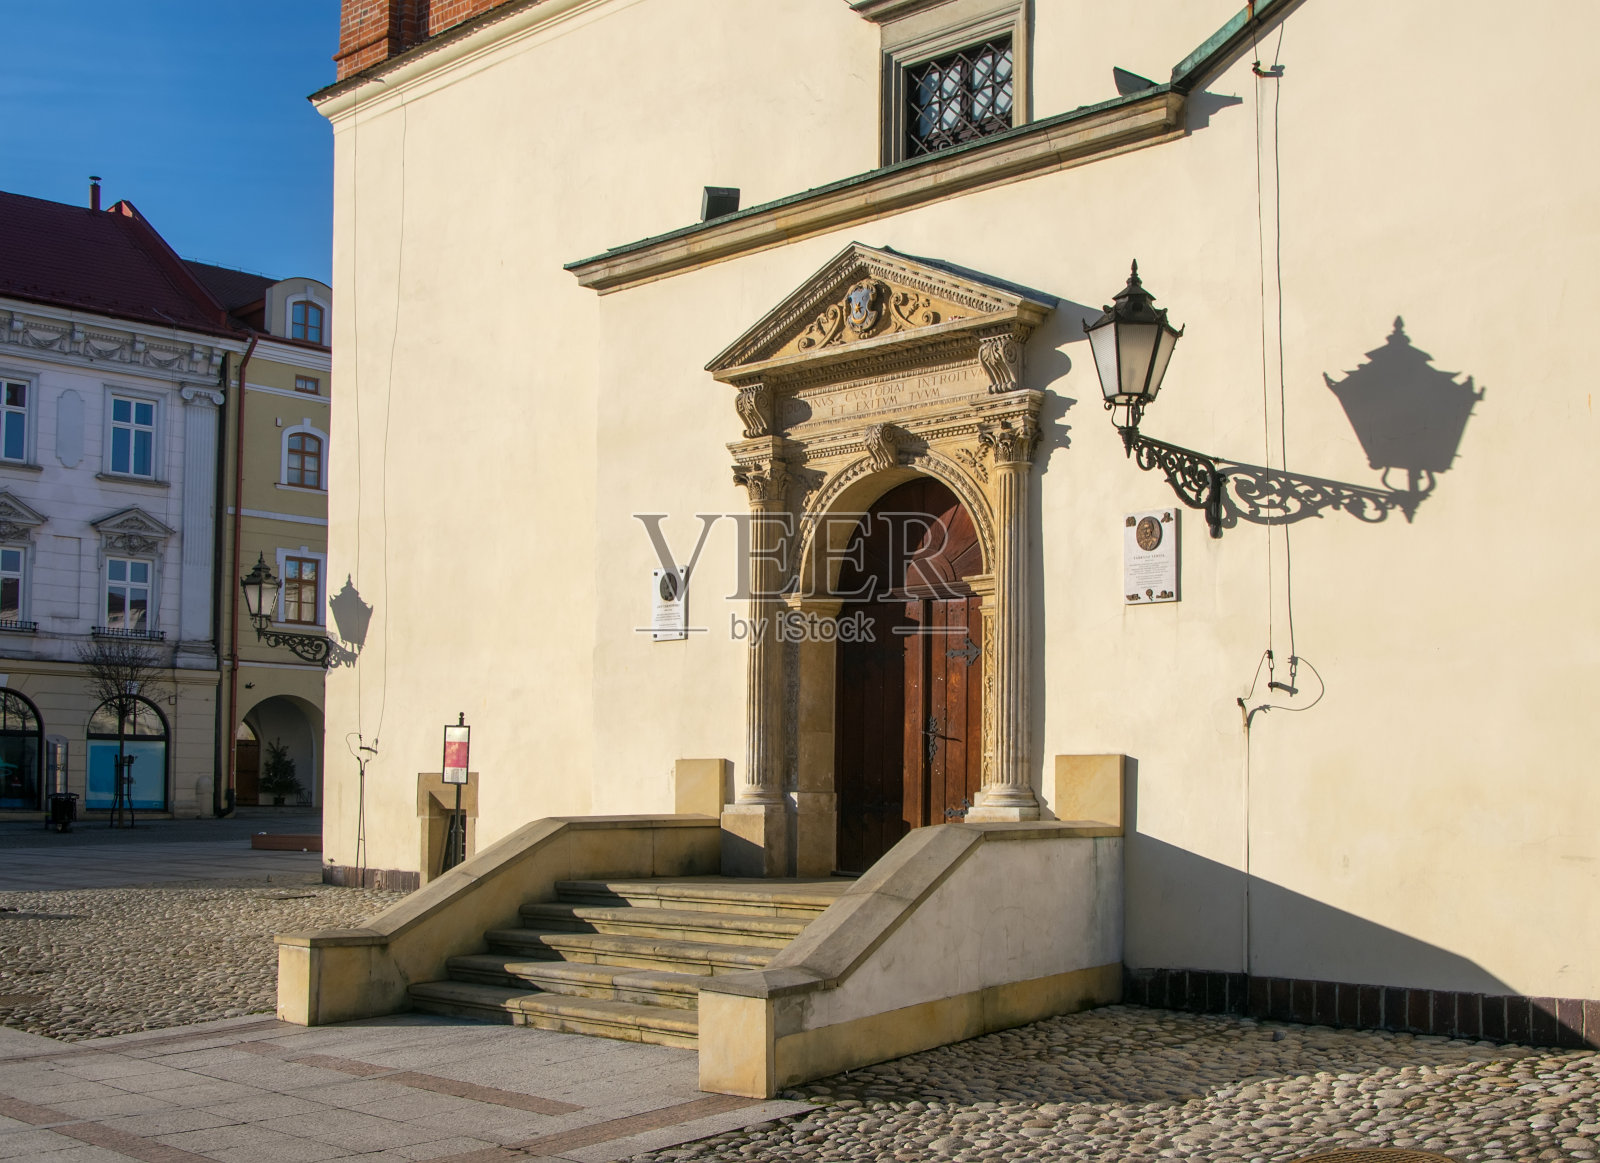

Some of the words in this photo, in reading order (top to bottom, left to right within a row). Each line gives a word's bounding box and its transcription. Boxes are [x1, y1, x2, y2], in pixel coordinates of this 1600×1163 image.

[845, 382, 905, 403] CVSTODIAT
[831, 404, 847, 417] ET
[856, 395, 898, 412] EXITVM
